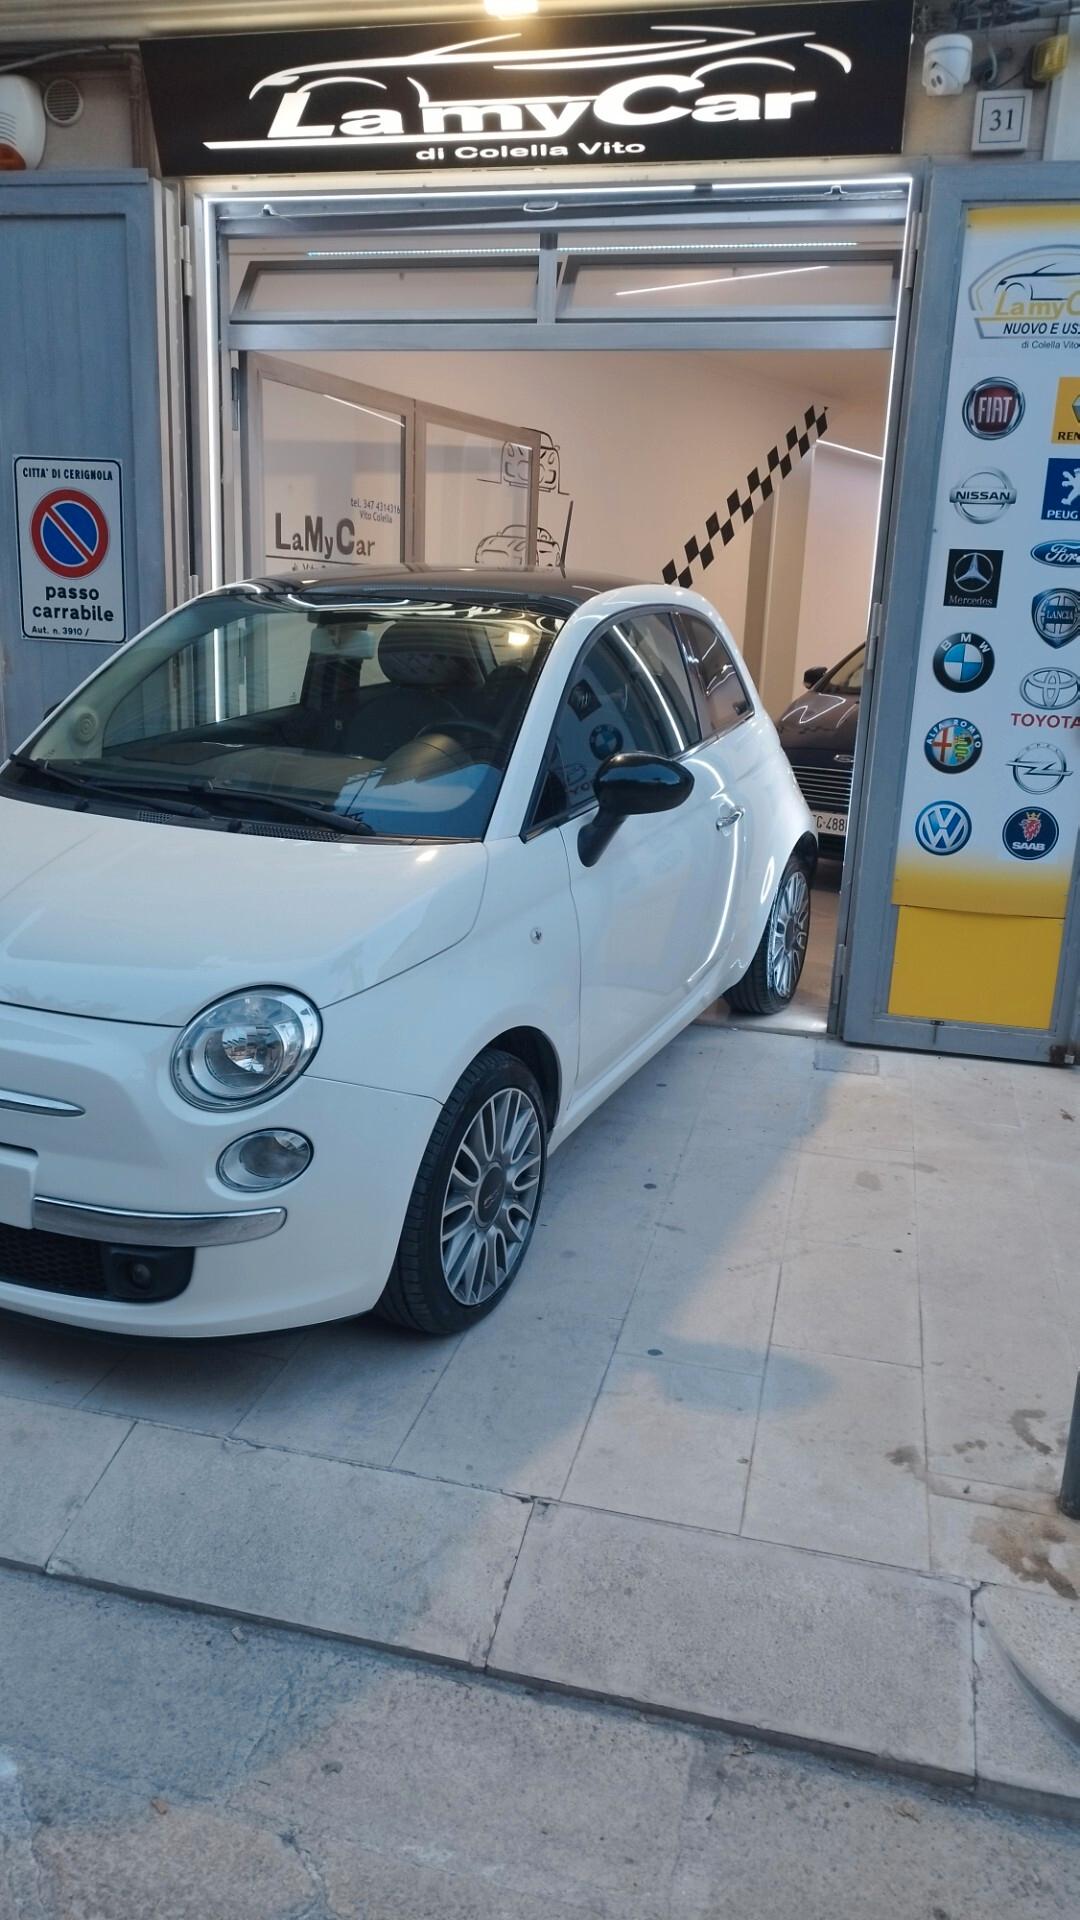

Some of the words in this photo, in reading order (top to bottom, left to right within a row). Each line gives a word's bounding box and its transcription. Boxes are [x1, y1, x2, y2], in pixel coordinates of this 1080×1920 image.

[989, 108, 1014, 131] 31
[416, 148, 445, 160] di
[454, 144, 569, 158] Colella
[577, 141, 646, 155] Vito
[1003, 322, 1048, 335] NUOVO
[1049, 322, 1060, 335] E
[1062, 322, 1080, 335] US
[1031, 341, 1061, 350] Colella
[977, 396, 1013, 424] FIAT
[52, 469, 61, 479] DI
[63, 469, 113, 481] CERIGNOLA
[955, 491, 1010, 501] NISSAN
[275, 512, 376, 560] LaMyCar
[45, 586, 100, 600] passo
[32, 605, 115, 622] carrabile
[62, 627, 83, 636] 3910
[941, 633, 991, 653] BMW
[1010, 712, 1080, 729] TOYOTA
[1012, 841, 1046, 851] SAAB
